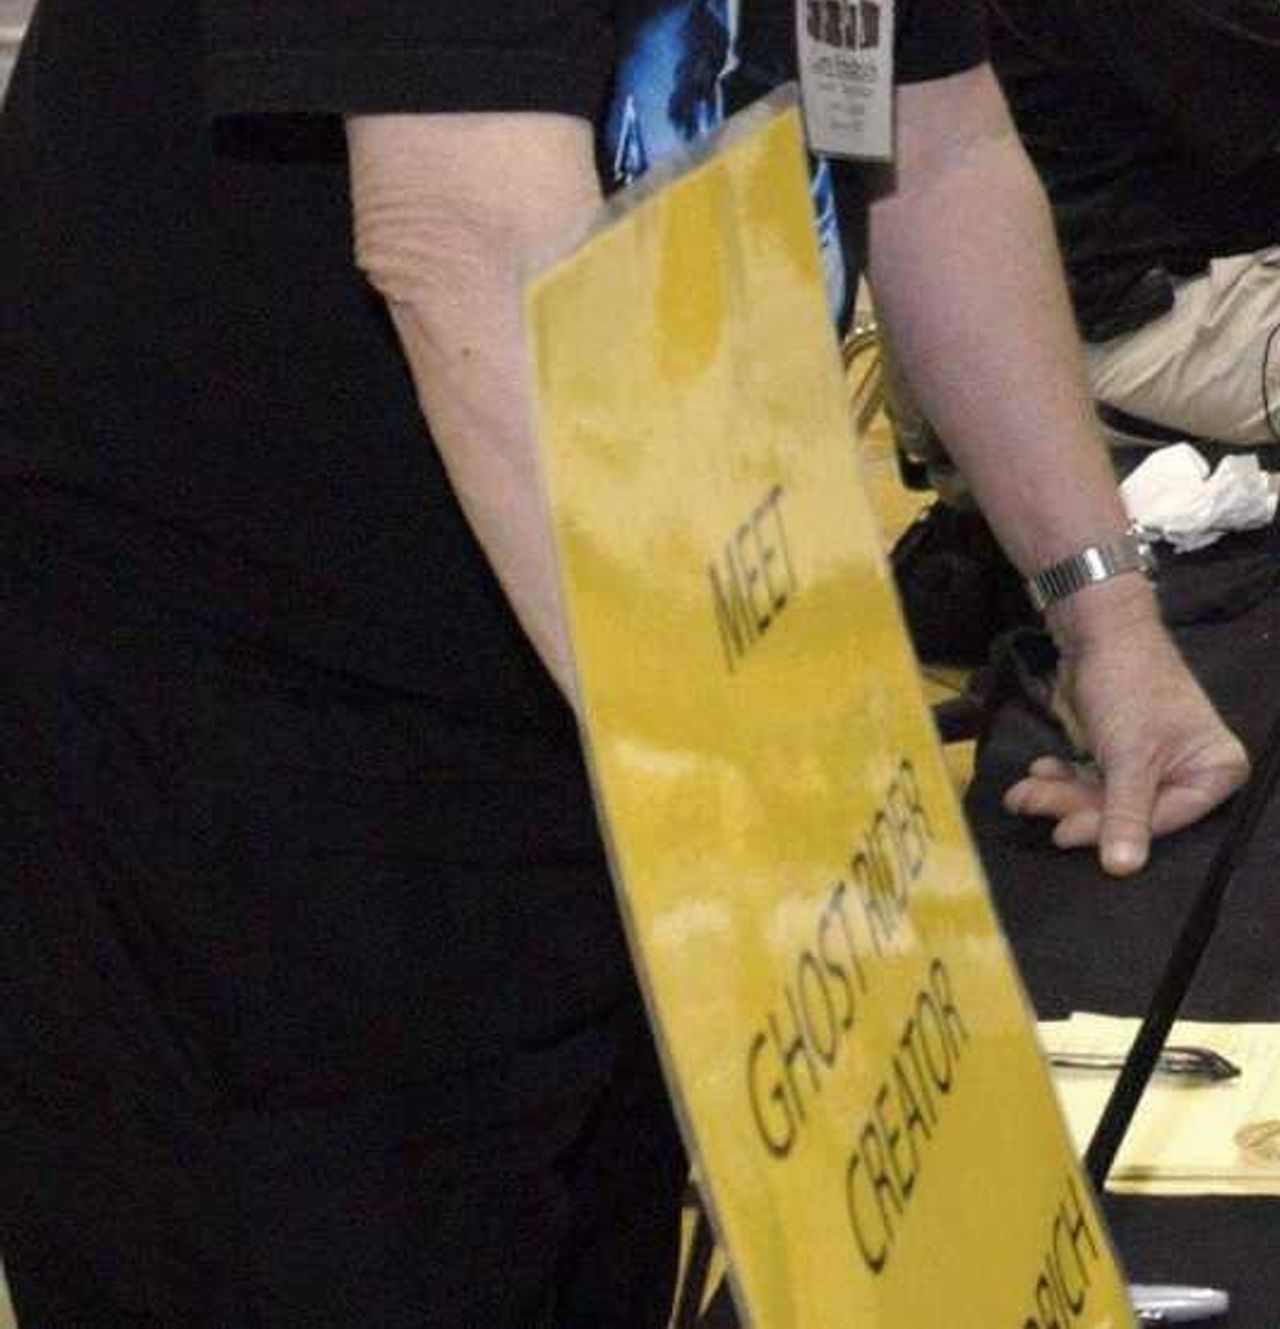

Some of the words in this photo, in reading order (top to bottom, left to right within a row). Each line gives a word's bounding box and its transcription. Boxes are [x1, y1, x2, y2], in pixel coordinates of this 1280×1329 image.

[708, 483, 796, 675] MEET
[746, 877, 868, 1160] GHOST
[851, 756, 936, 957] RIDER
[844, 954, 970, 1275] CREATOR
